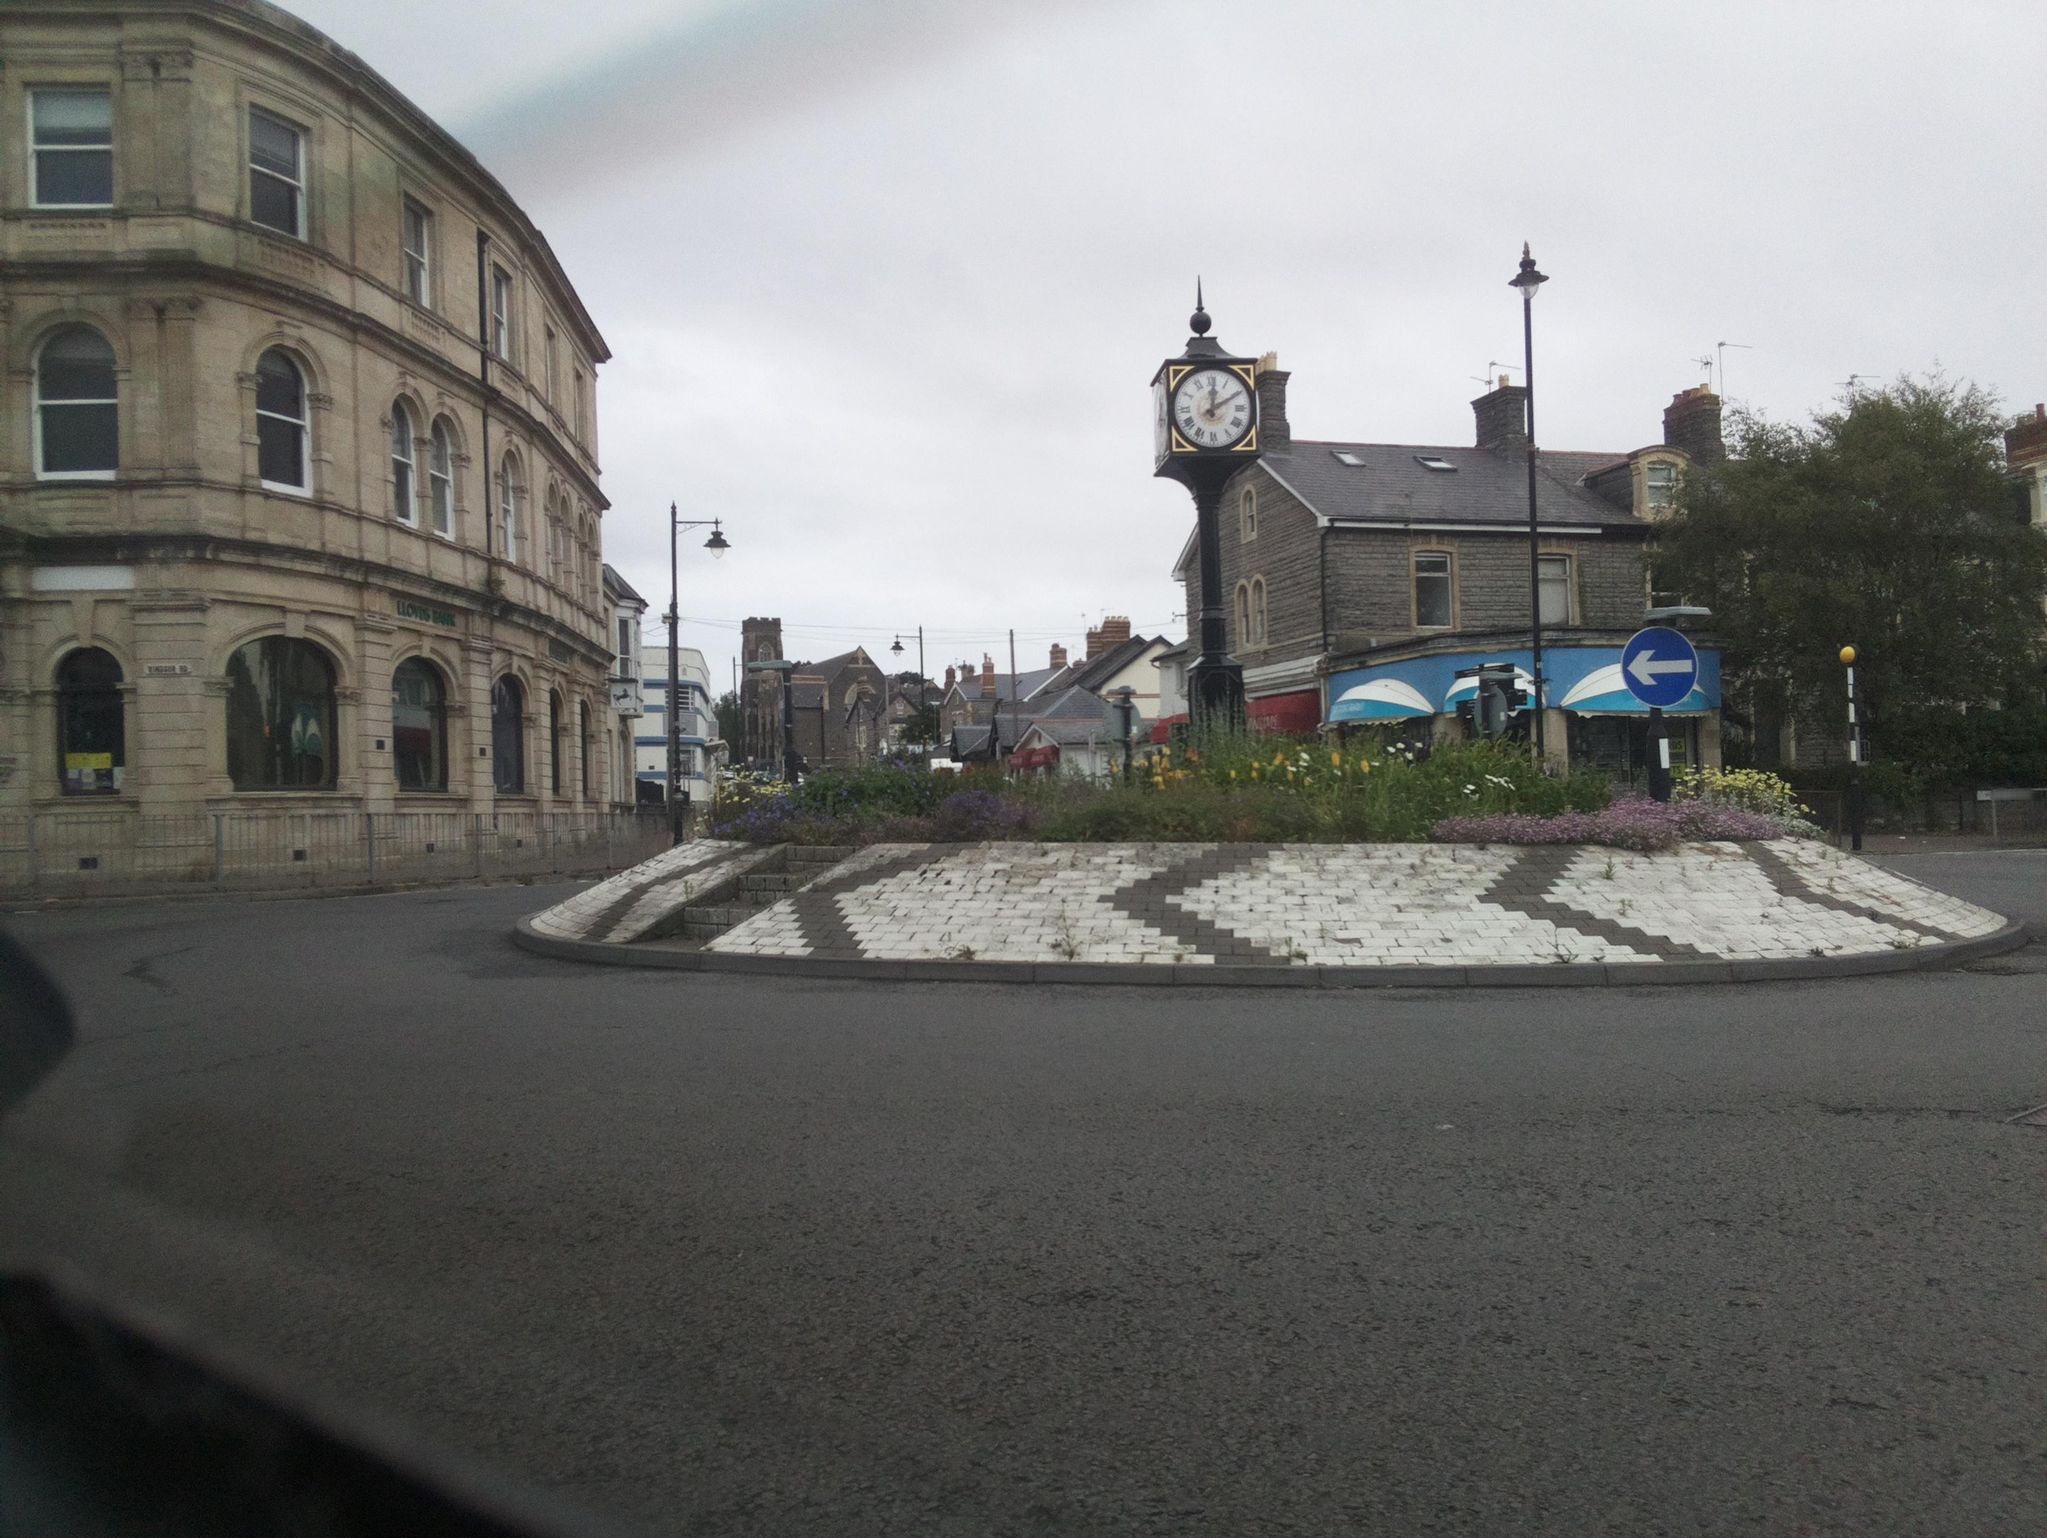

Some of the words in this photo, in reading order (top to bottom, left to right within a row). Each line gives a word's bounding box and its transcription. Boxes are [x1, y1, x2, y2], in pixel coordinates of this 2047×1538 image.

[397, 600, 432, 622] LLOYDS
[432, 608, 456, 627] BANK
[148, 665, 176, 673] WINDSOR
